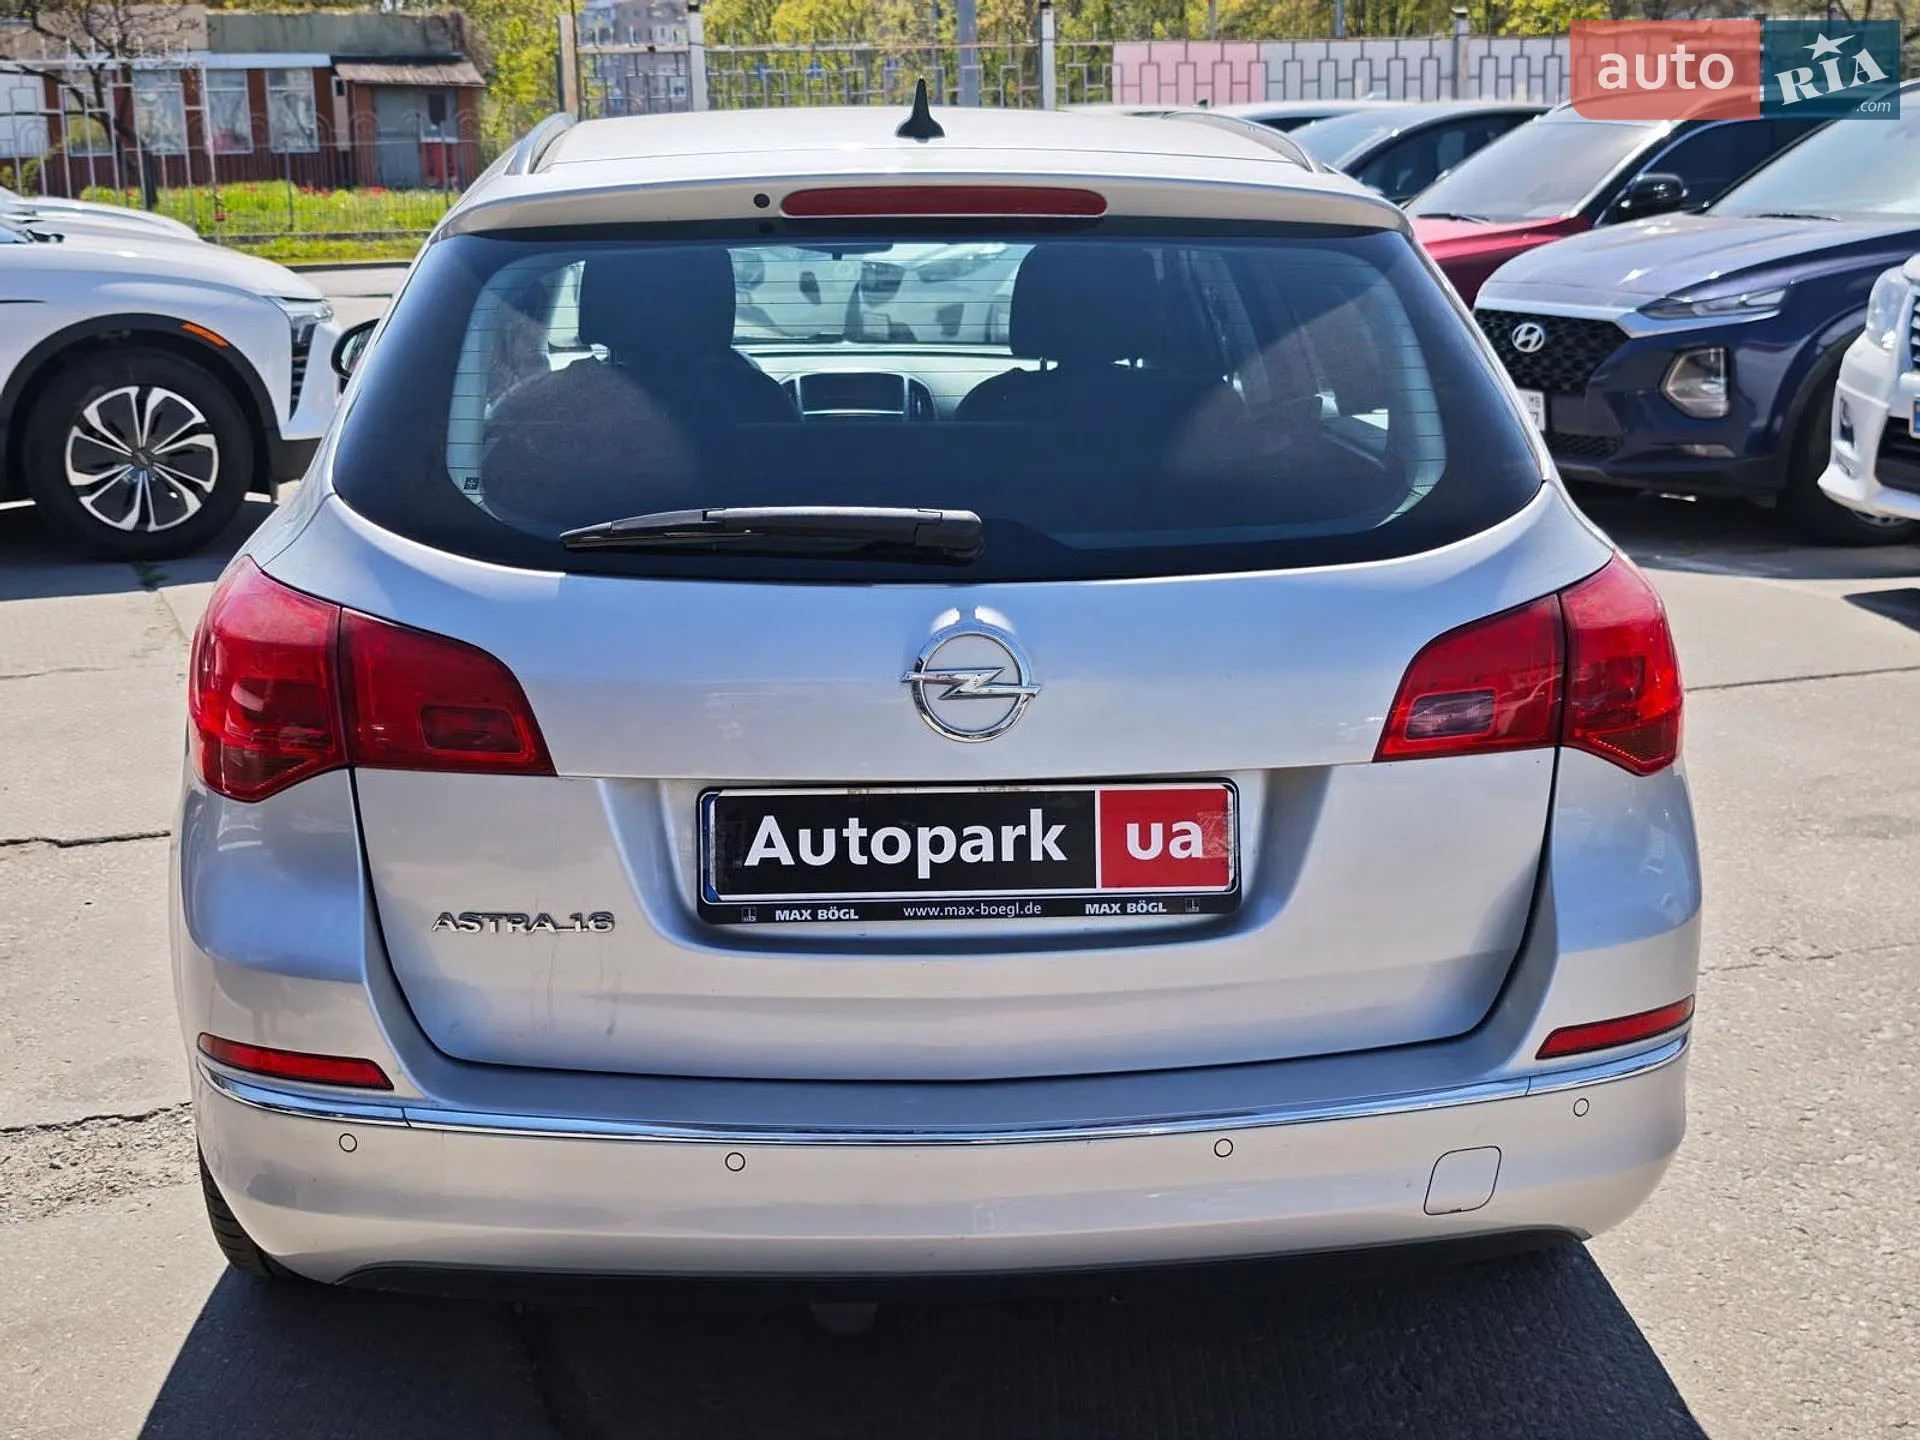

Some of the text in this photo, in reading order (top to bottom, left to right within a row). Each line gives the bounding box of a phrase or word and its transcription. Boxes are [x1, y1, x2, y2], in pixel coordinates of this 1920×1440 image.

[744, 808, 1202, 879] Autopark ua
[775, 906, 859, 921] MAX BÖGL
[903, 904, 1043, 918] www.max-boegl.de
[1085, 900, 1167, 915] MAX BÖGL
[432, 911, 557, 933] ASTRA
